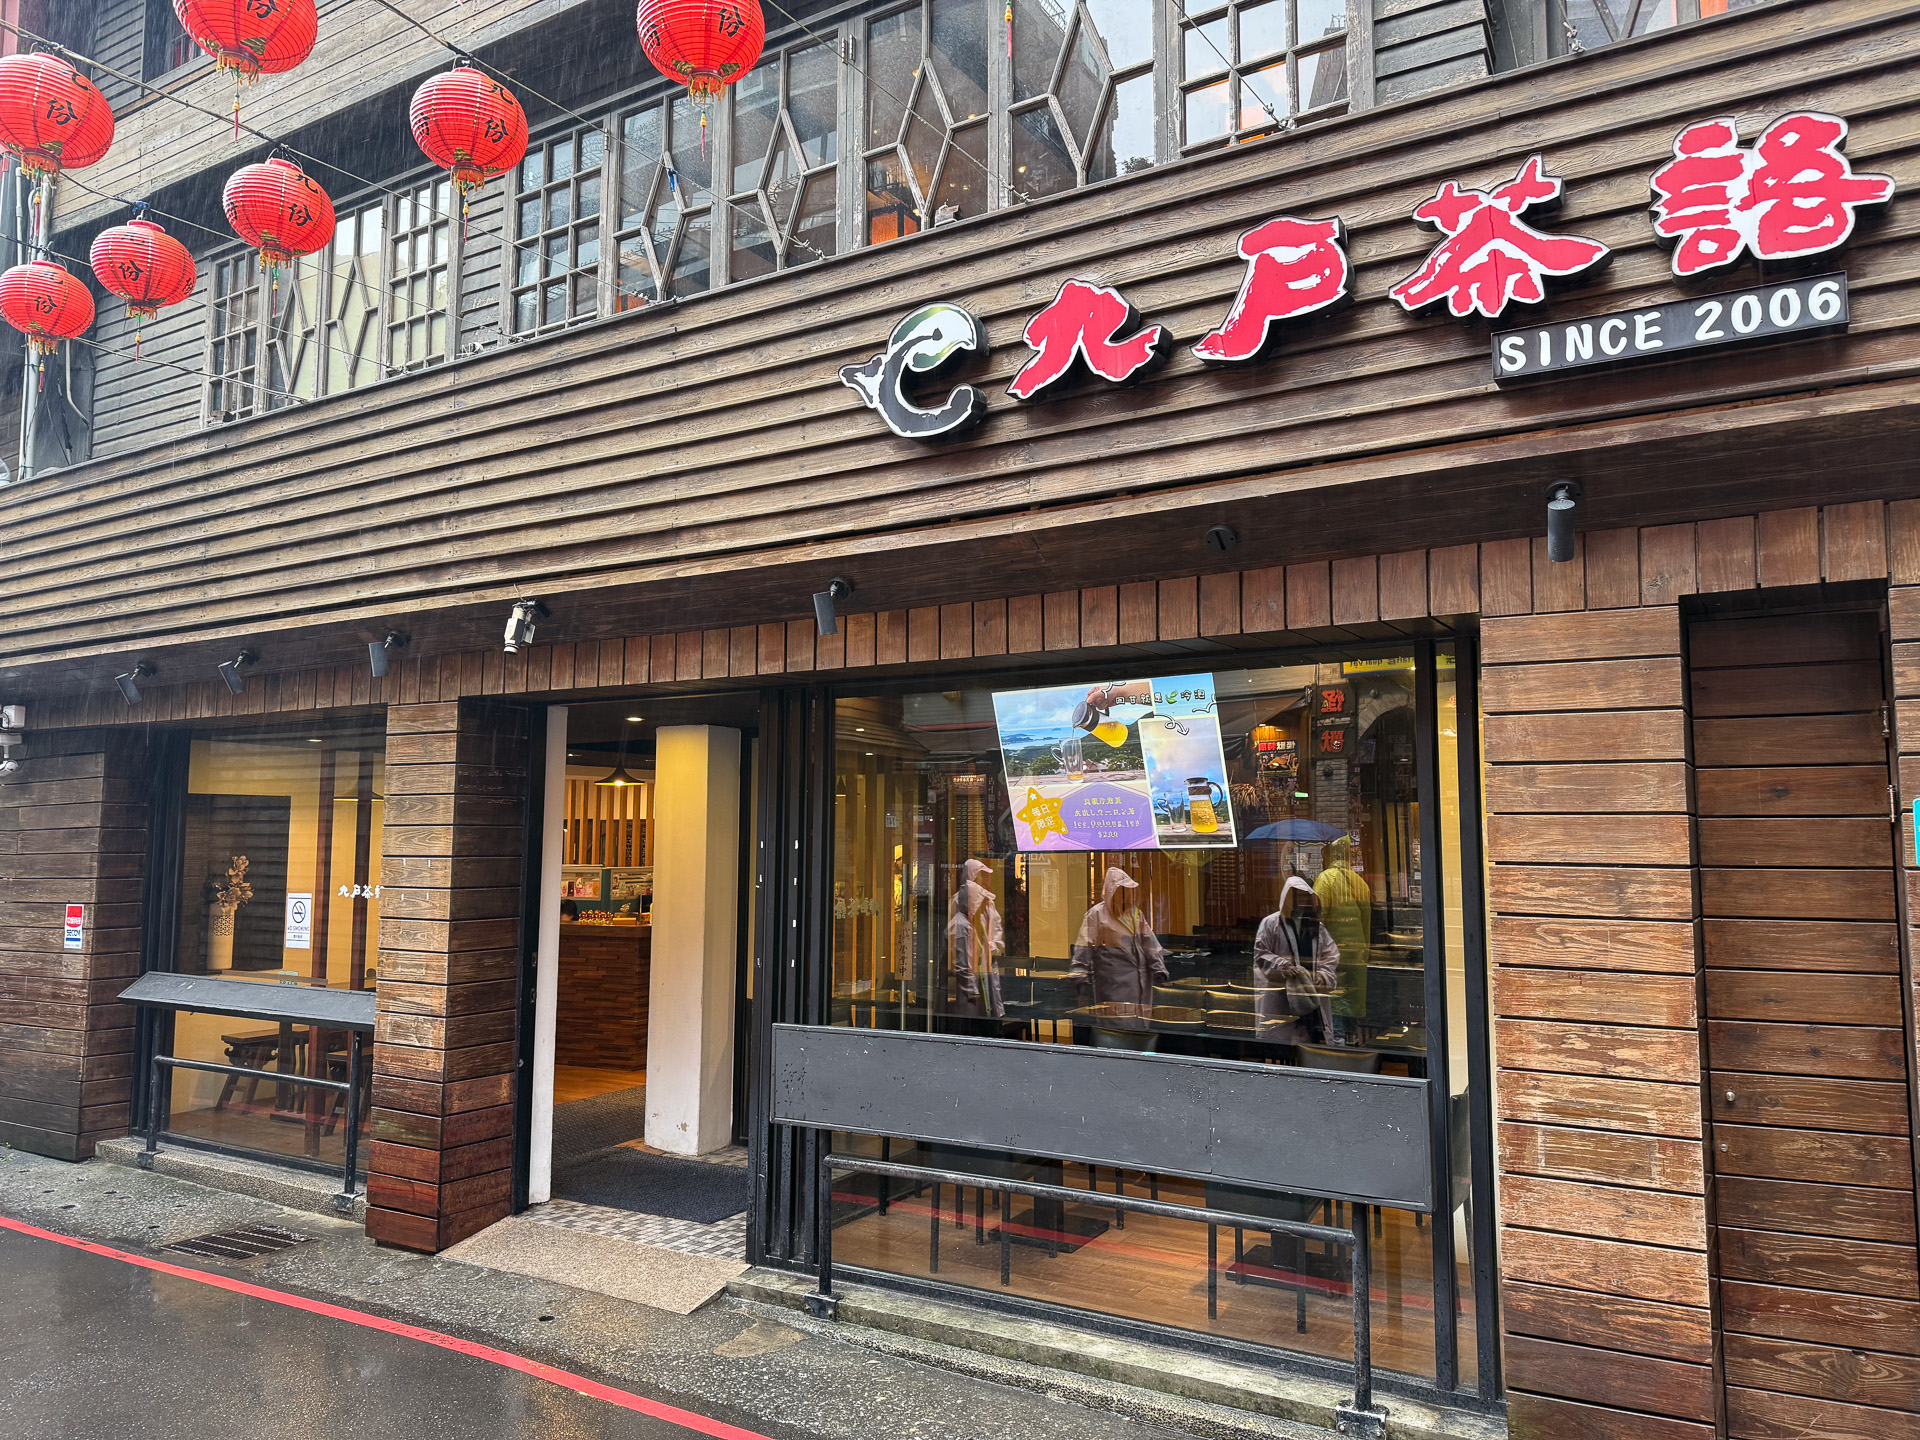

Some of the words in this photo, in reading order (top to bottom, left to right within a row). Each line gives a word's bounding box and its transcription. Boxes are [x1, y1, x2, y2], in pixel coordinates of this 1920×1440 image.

[718, 5, 746, 38] 份
[484, 83, 515, 144] 九份
[288, 173, 319, 227] 九份
[1006, 110, 1896, 400] 九戶茶語
[1500, 311, 1663, 372] SINCE
[1694, 281, 1841, 342] 2006
[1031, 803, 1050, 817] 每日
[1036, 815, 1056, 830] 限定
